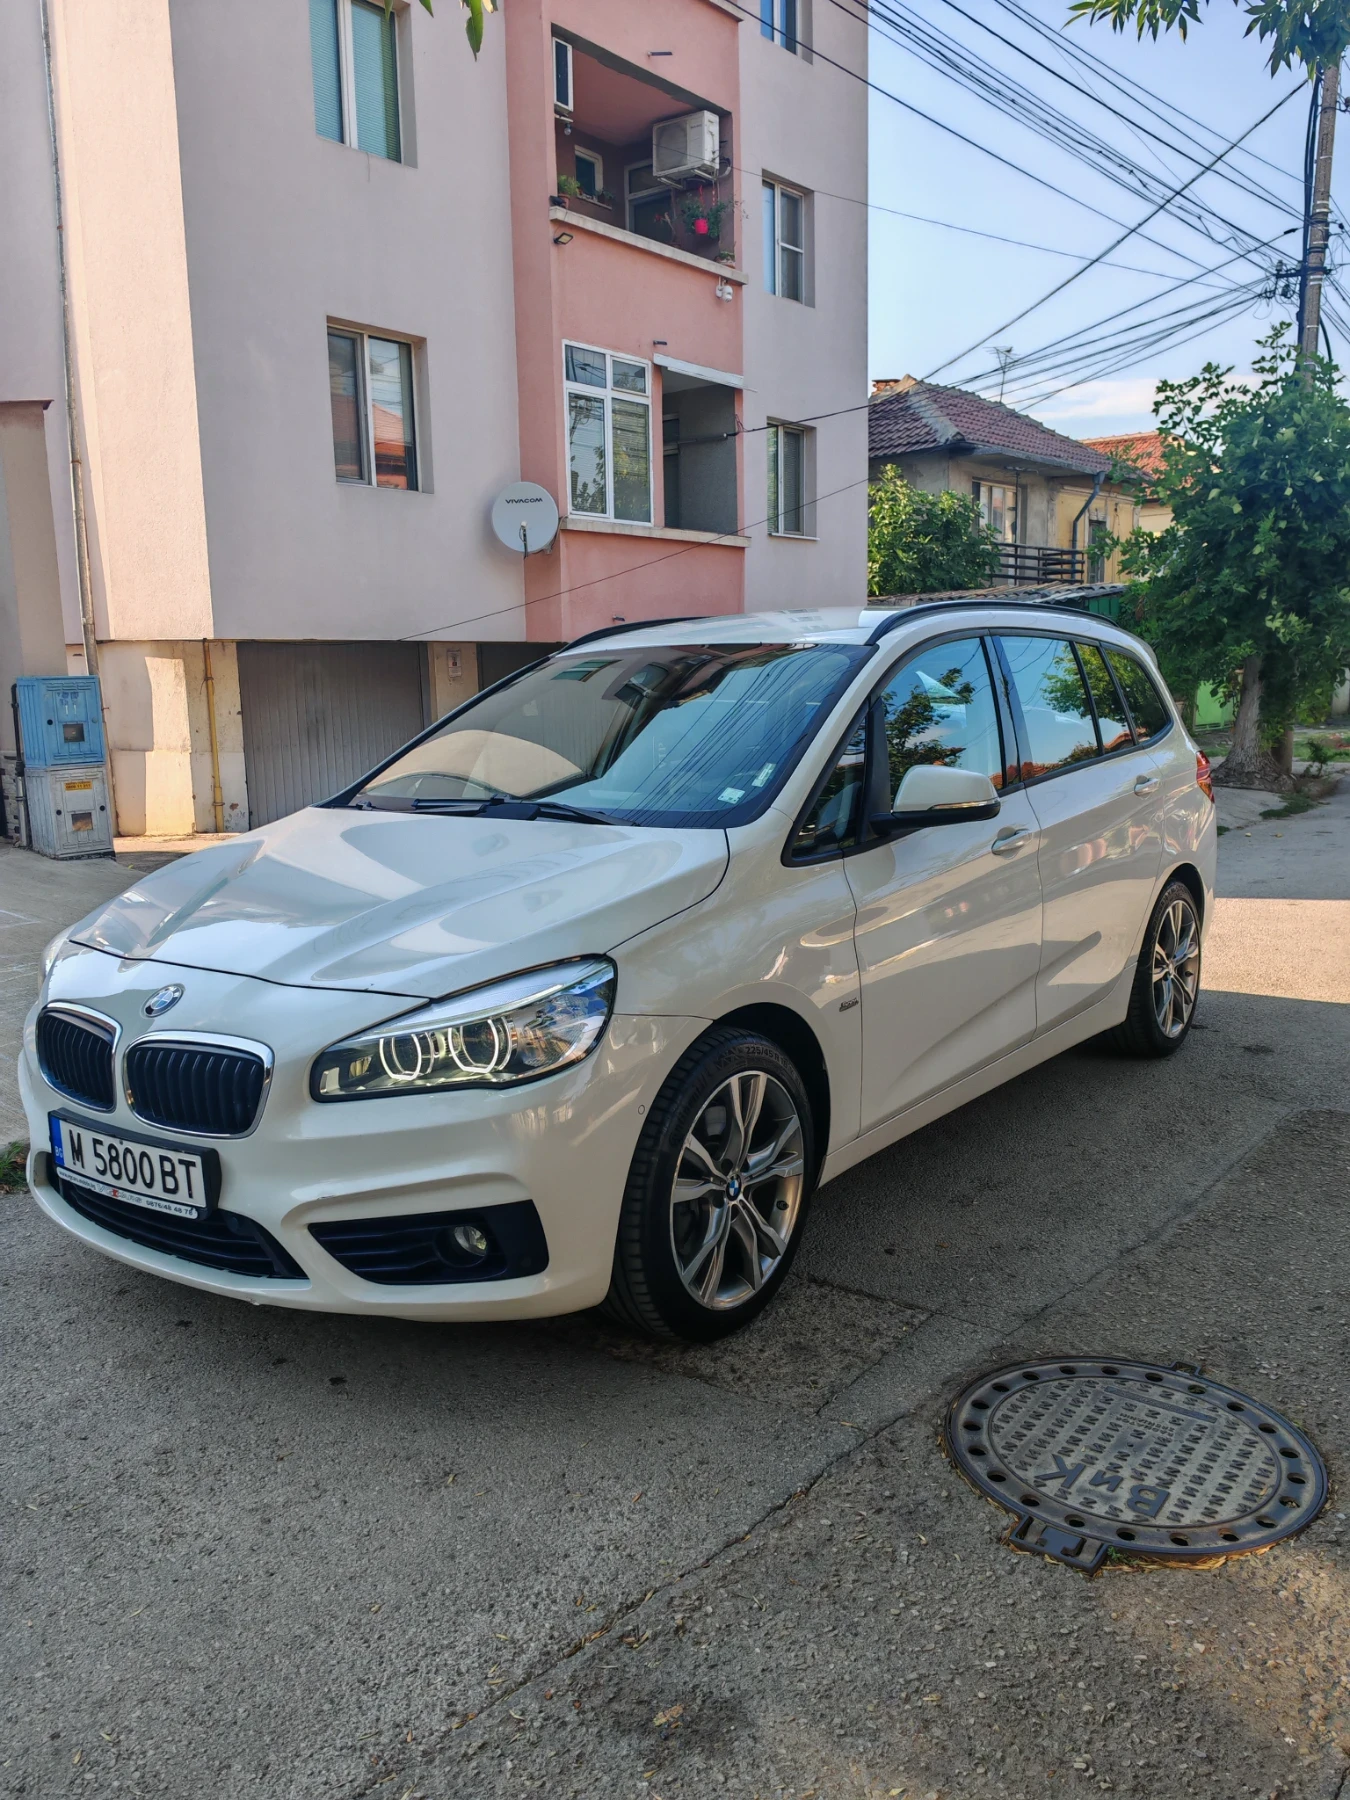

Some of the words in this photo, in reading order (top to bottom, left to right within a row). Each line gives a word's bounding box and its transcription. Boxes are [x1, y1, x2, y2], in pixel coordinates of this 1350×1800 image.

[745, 1046, 774, 1058] 225/45
[55, 1145, 63, 1158] BG
[69, 1129, 85, 1169] M
[92, 1137, 155, 1189] 5800
[159, 1154, 197, 1199] BT
